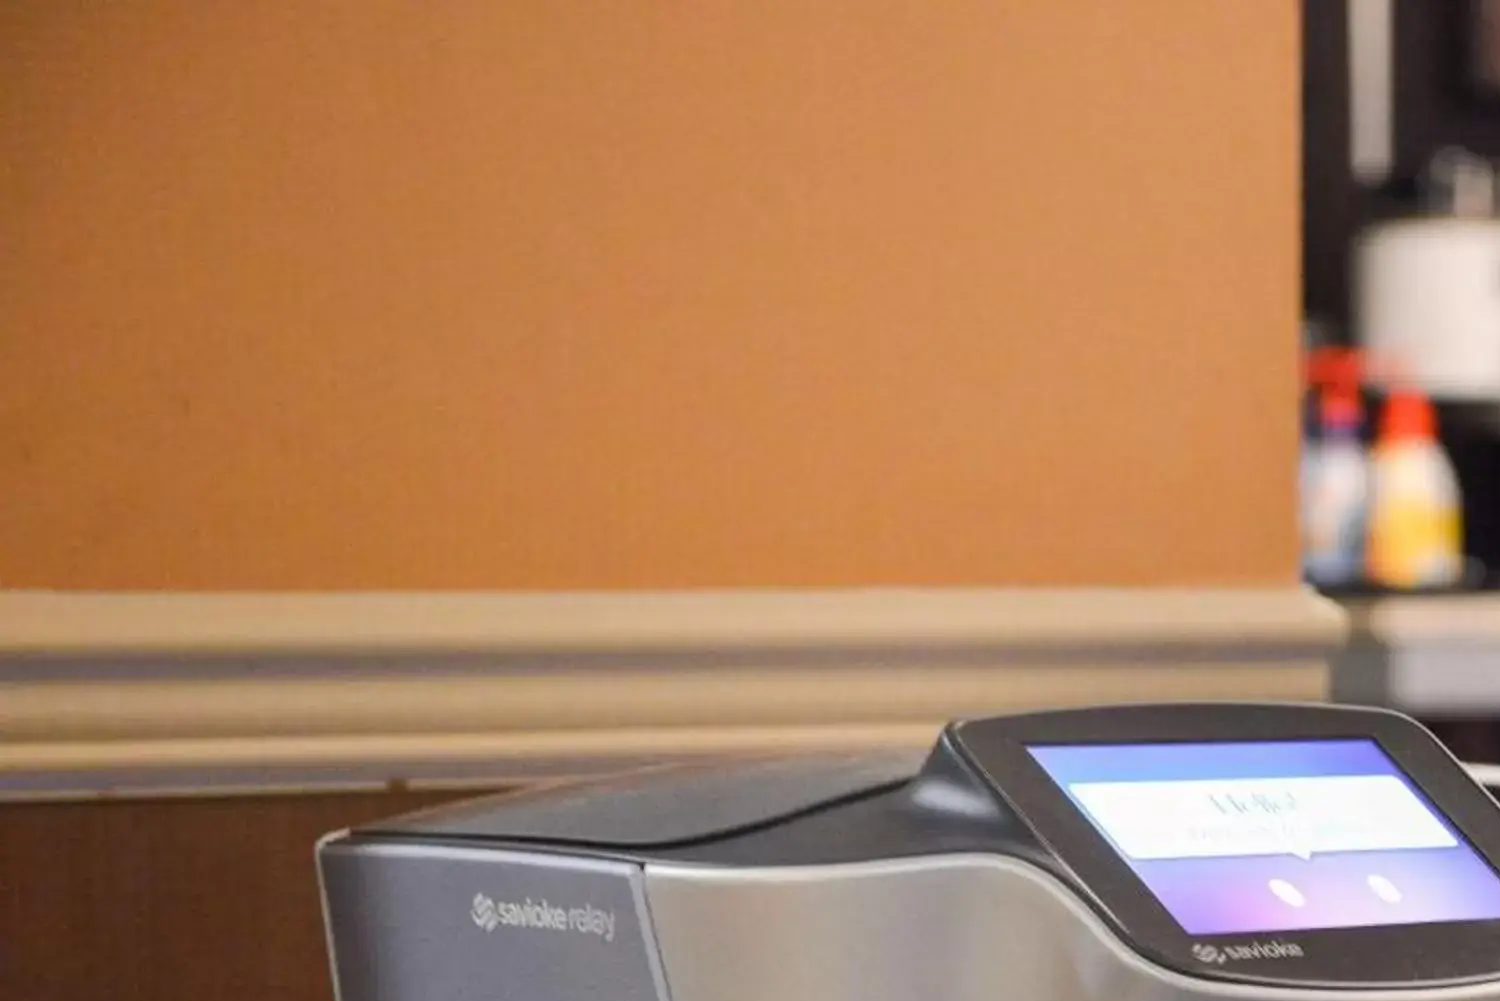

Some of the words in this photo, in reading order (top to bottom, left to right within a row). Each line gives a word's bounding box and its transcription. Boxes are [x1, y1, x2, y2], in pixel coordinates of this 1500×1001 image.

[498, 897, 567, 930] savioke
[568, 903, 615, 942] relay
[1224, 939, 1304, 960] savioke
